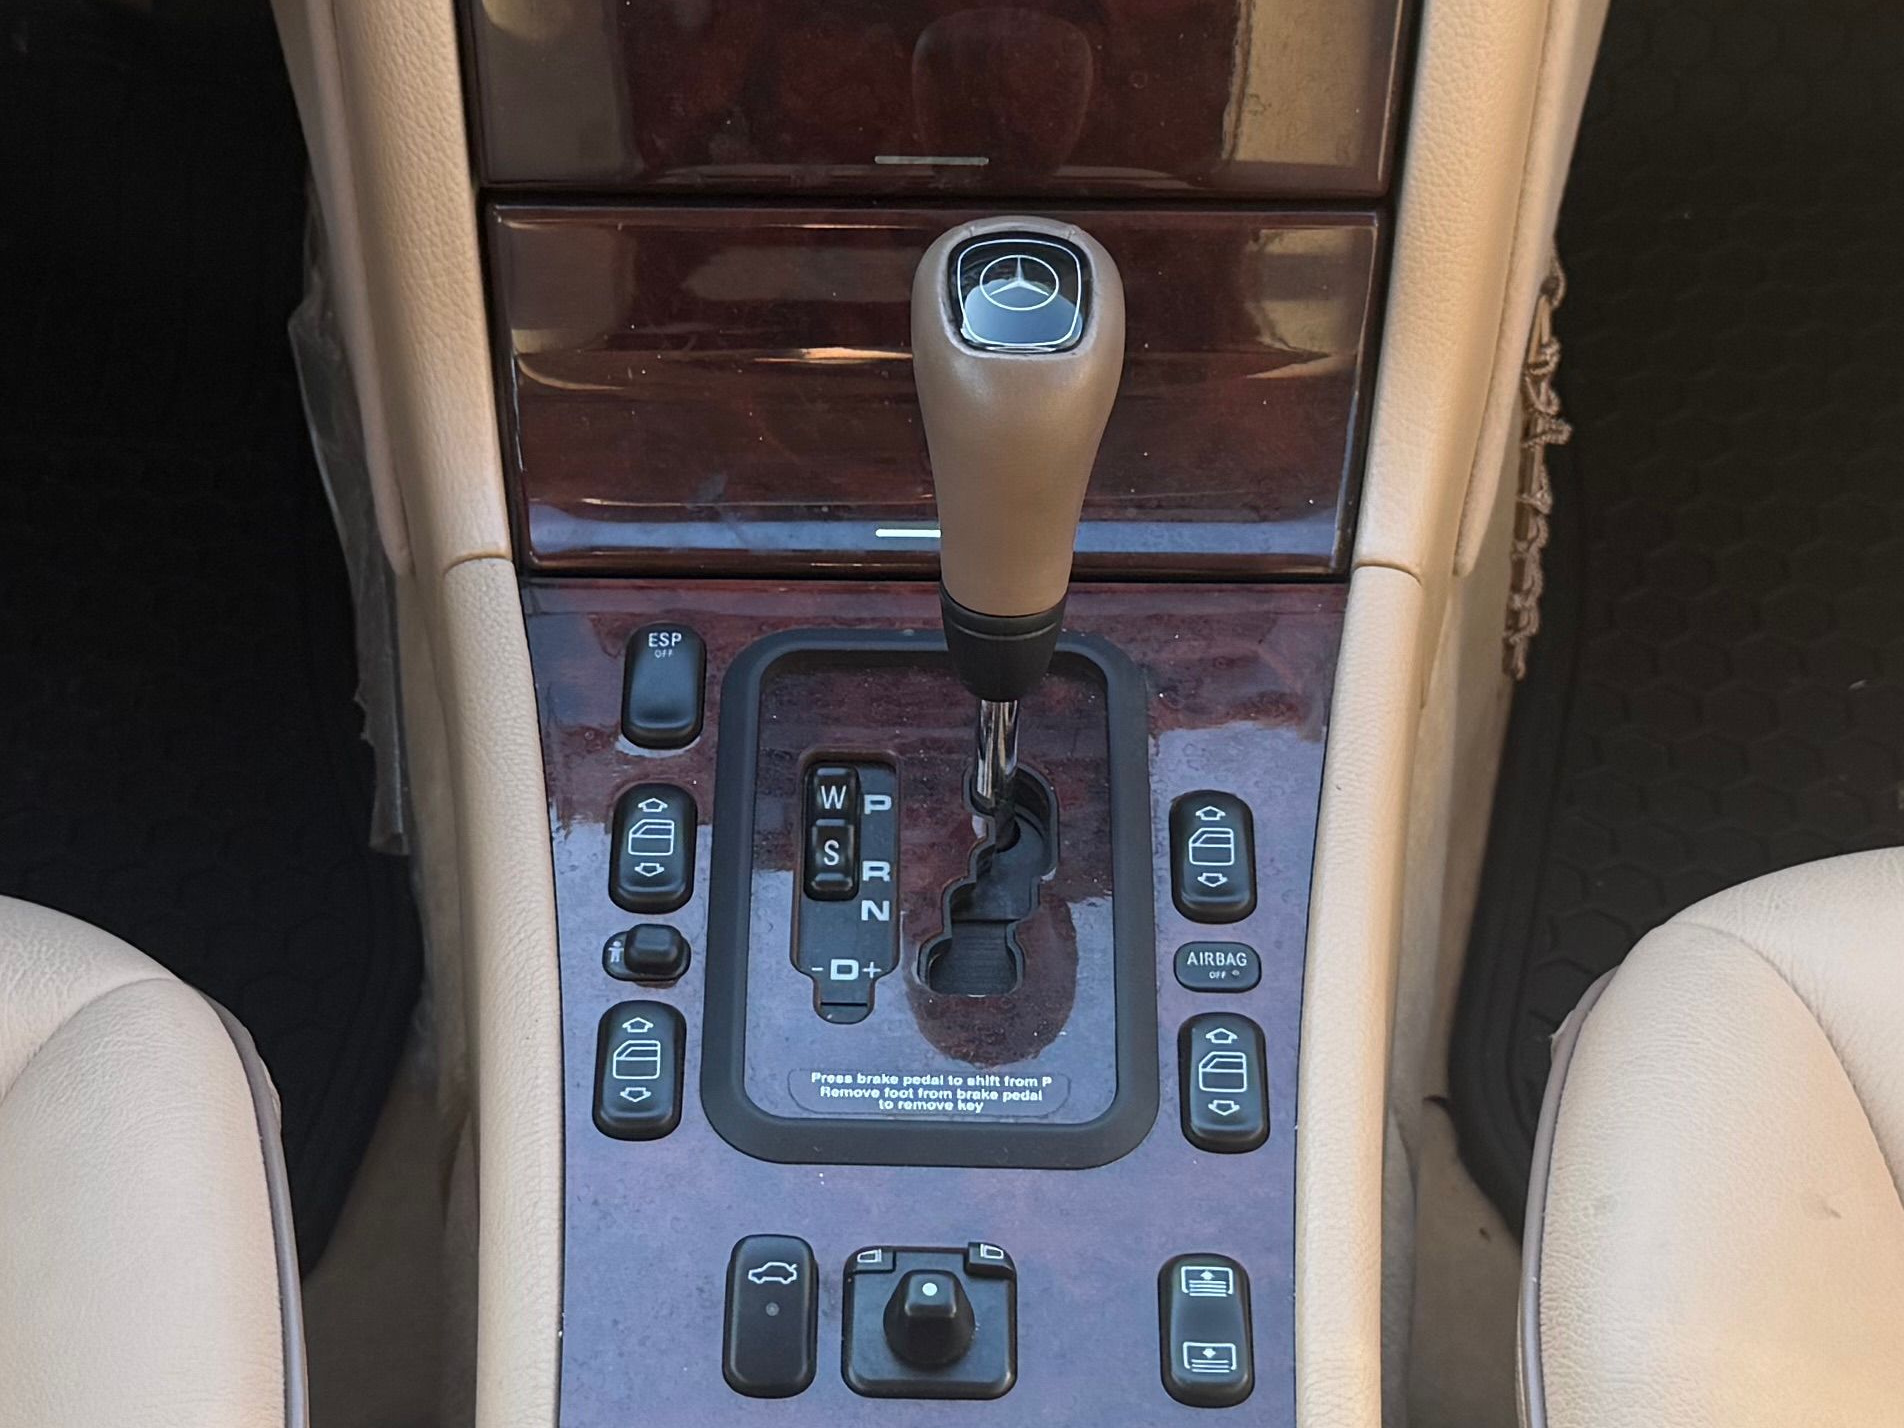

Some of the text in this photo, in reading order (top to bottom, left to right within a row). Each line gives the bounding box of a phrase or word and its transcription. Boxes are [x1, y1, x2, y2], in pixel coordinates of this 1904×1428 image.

[648, 632, 682, 648] ESP
[654, 649, 673, 659] OFF
[820, 784, 847, 810] W
[863, 794, 892, 815] P
[823, 839, 841, 866] S
[862, 860, 891, 882] R
[860, 899, 890, 922] N
[1186, 951, 1248, 967] AIRBAG
[1208, 970, 1227, 980] OFF
[811, 1072, 1052, 1088] Press brake pedal to shift from P
[820, 1086, 1043, 1102] Remove foot from brake pedal
[879, 1098, 984, 1113] to remove key
